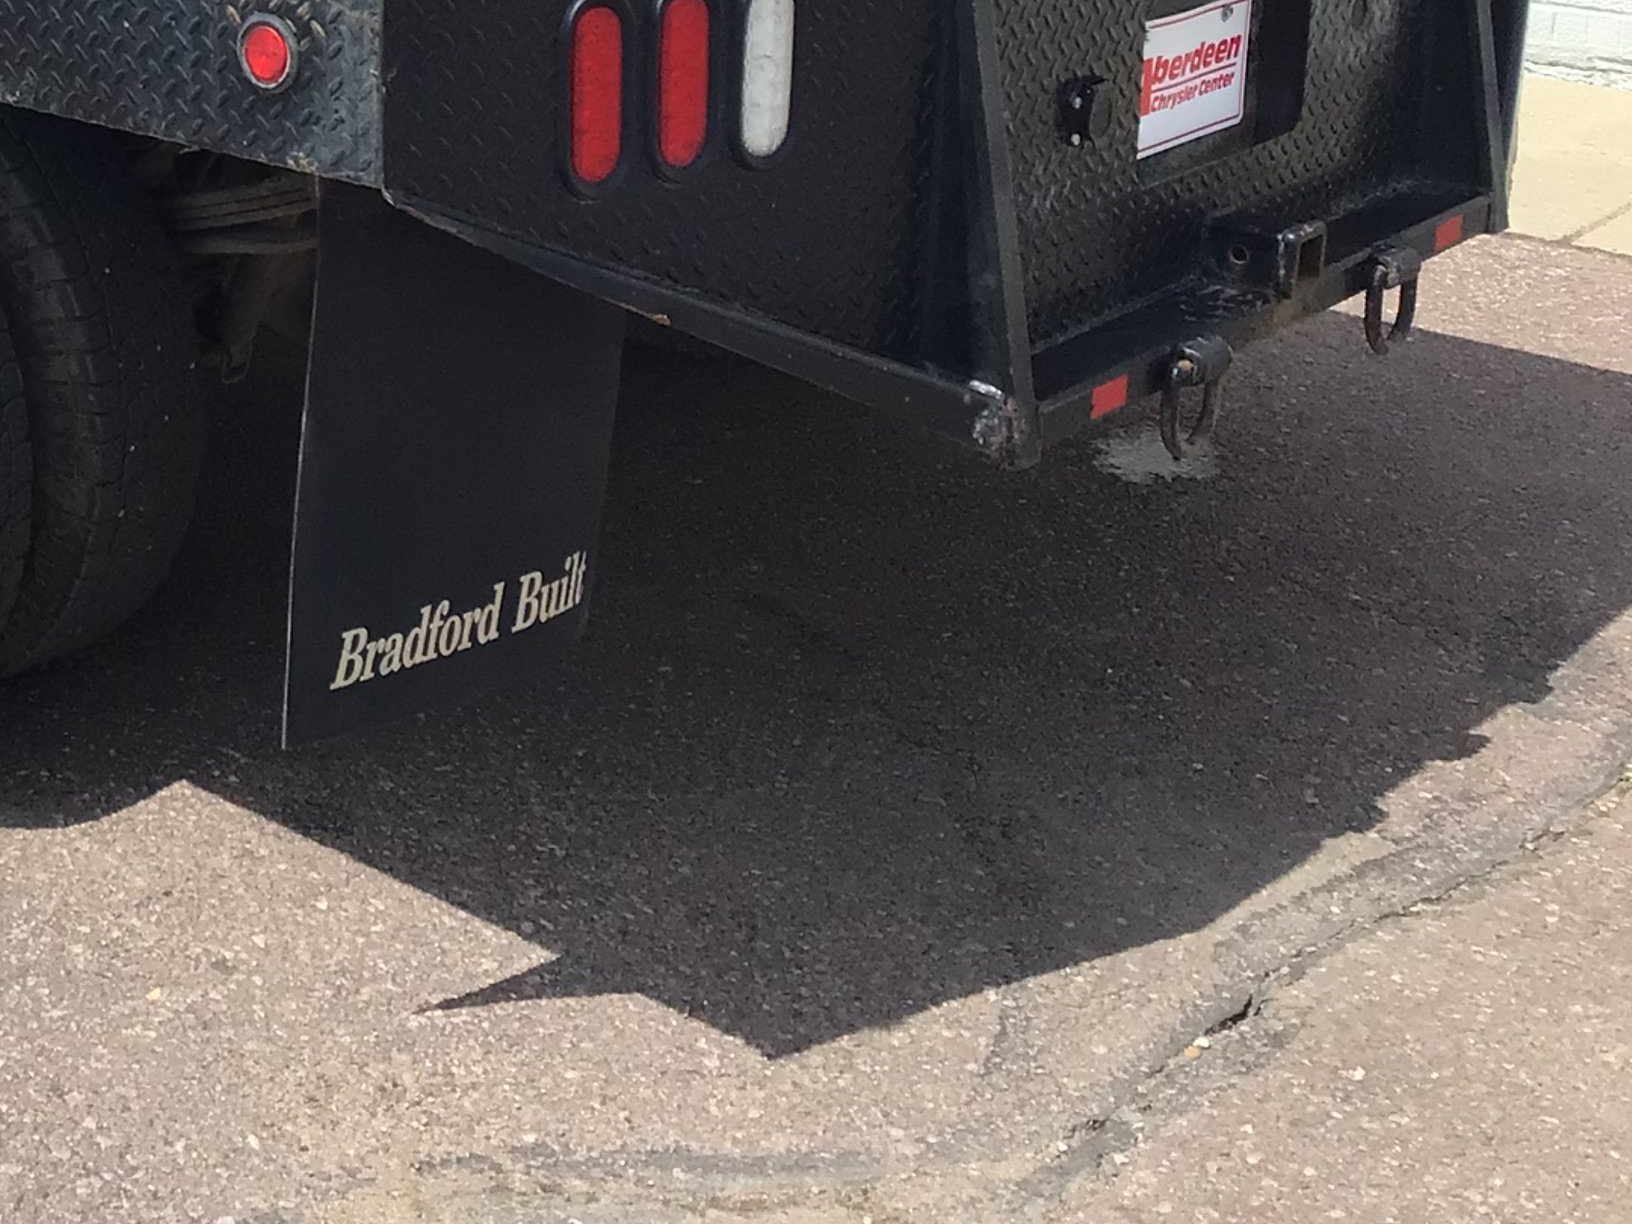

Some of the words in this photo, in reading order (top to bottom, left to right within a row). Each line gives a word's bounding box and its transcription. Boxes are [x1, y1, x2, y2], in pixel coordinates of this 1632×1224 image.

[1150, 84, 1199, 112] Chrysler
[1198, 71, 1235, 96] Center
[329, 581, 506, 691] Bradford
[511, 550, 588, 633] Built
